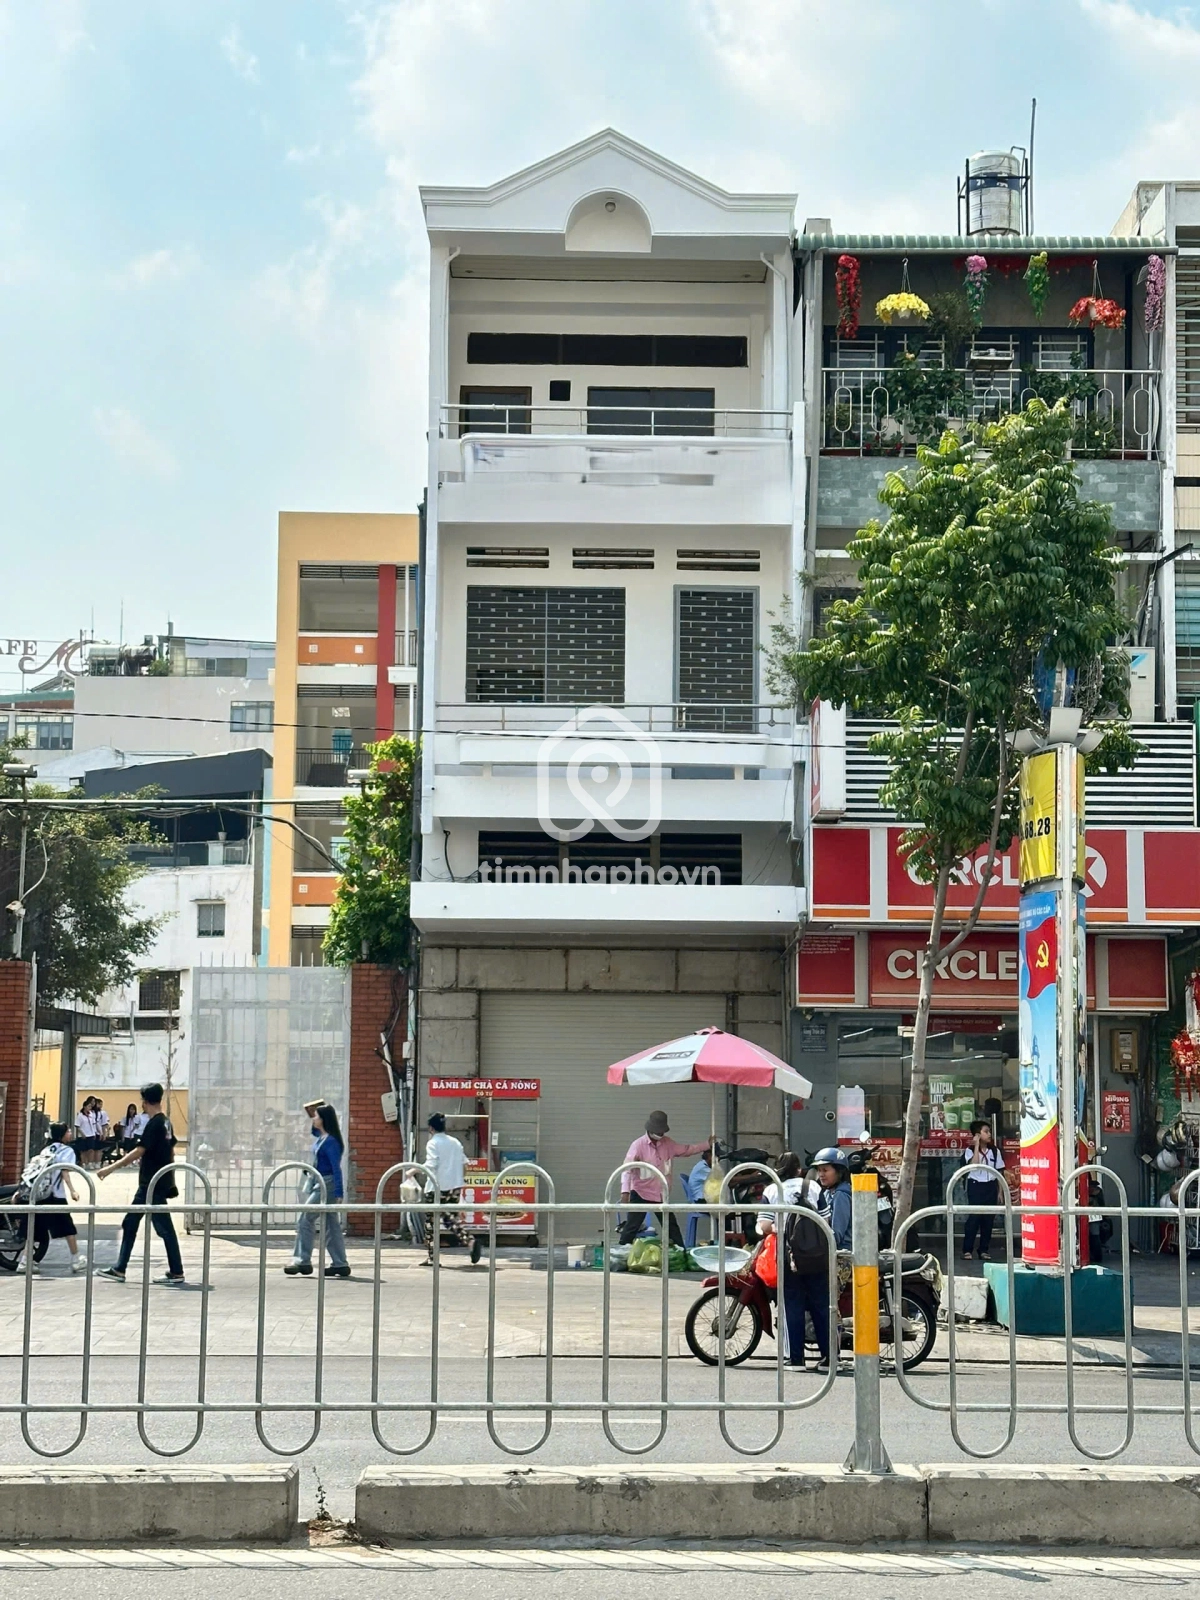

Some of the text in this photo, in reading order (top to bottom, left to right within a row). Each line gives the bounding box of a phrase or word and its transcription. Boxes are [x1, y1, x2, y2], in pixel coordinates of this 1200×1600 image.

[432, 1080, 459, 1089] BÁNH
[495, 1080, 508, 1089] CÁ
[930, 1082, 954, 1094] MATCHA
